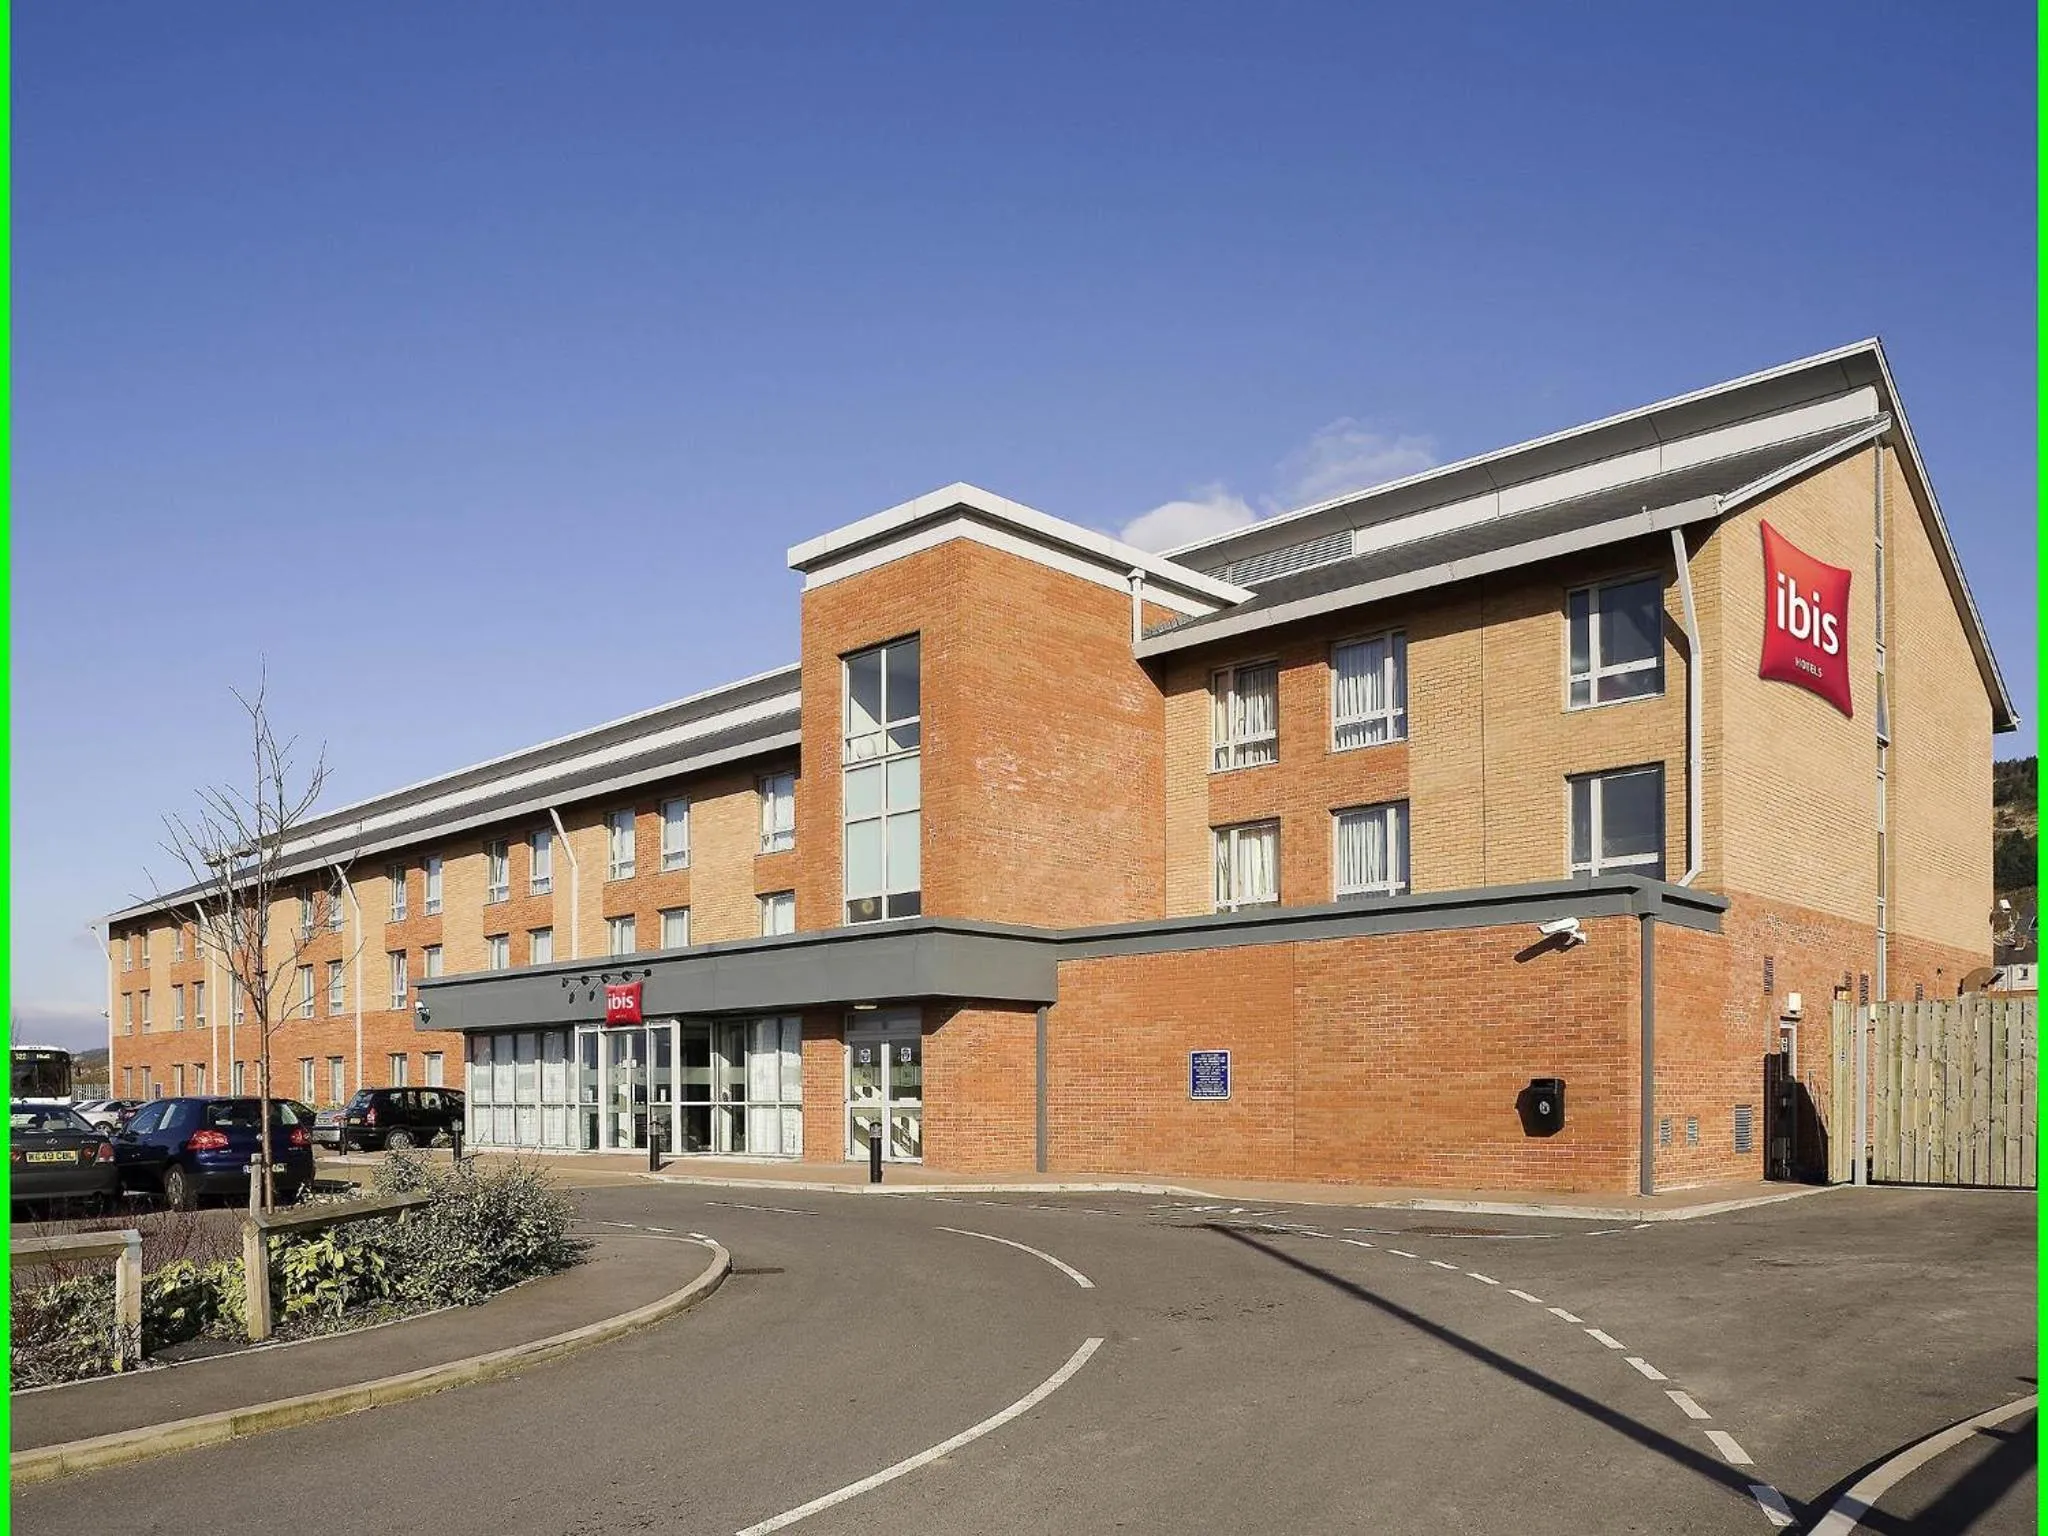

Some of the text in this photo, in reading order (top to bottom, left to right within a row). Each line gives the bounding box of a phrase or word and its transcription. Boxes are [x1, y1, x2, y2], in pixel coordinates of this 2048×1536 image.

[1777, 571, 1839, 655] ibis
[1794, 656, 1823, 678] HOTELS
[608, 992, 634, 1010] ibis
